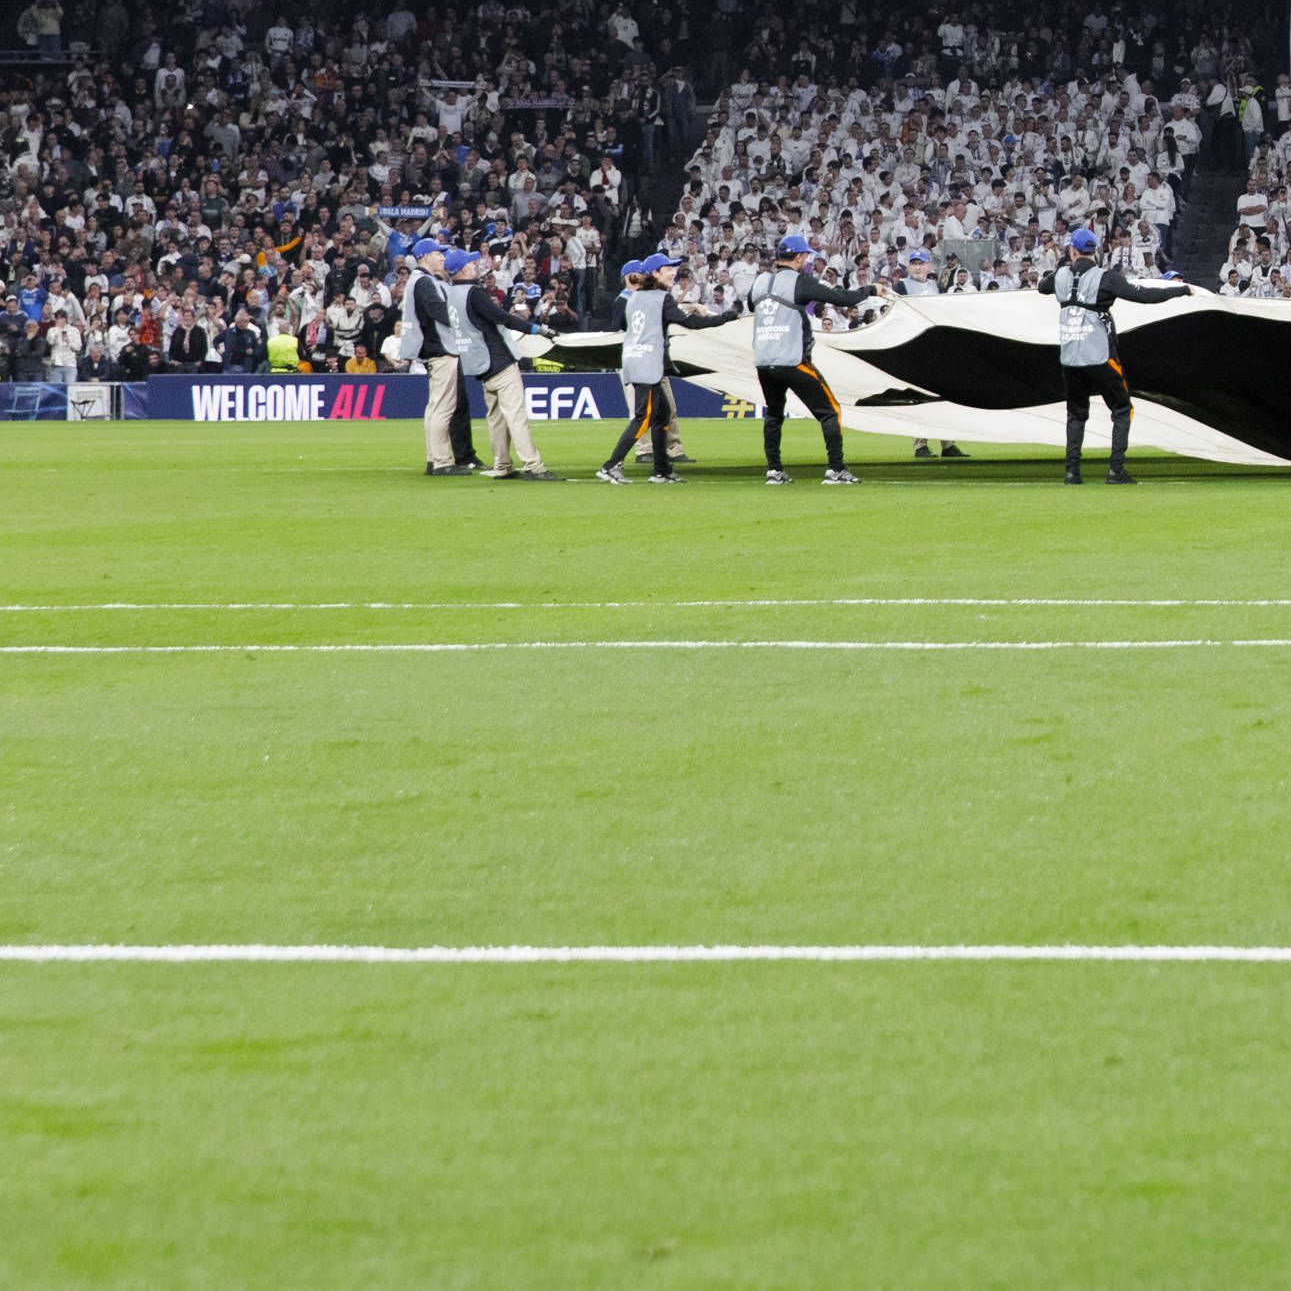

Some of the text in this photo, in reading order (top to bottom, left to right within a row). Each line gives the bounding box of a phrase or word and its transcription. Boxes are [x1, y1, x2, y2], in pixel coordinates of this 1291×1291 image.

[192, 384, 386, 421] WELCOME ALL
[524, 386, 602, 419] EFA
